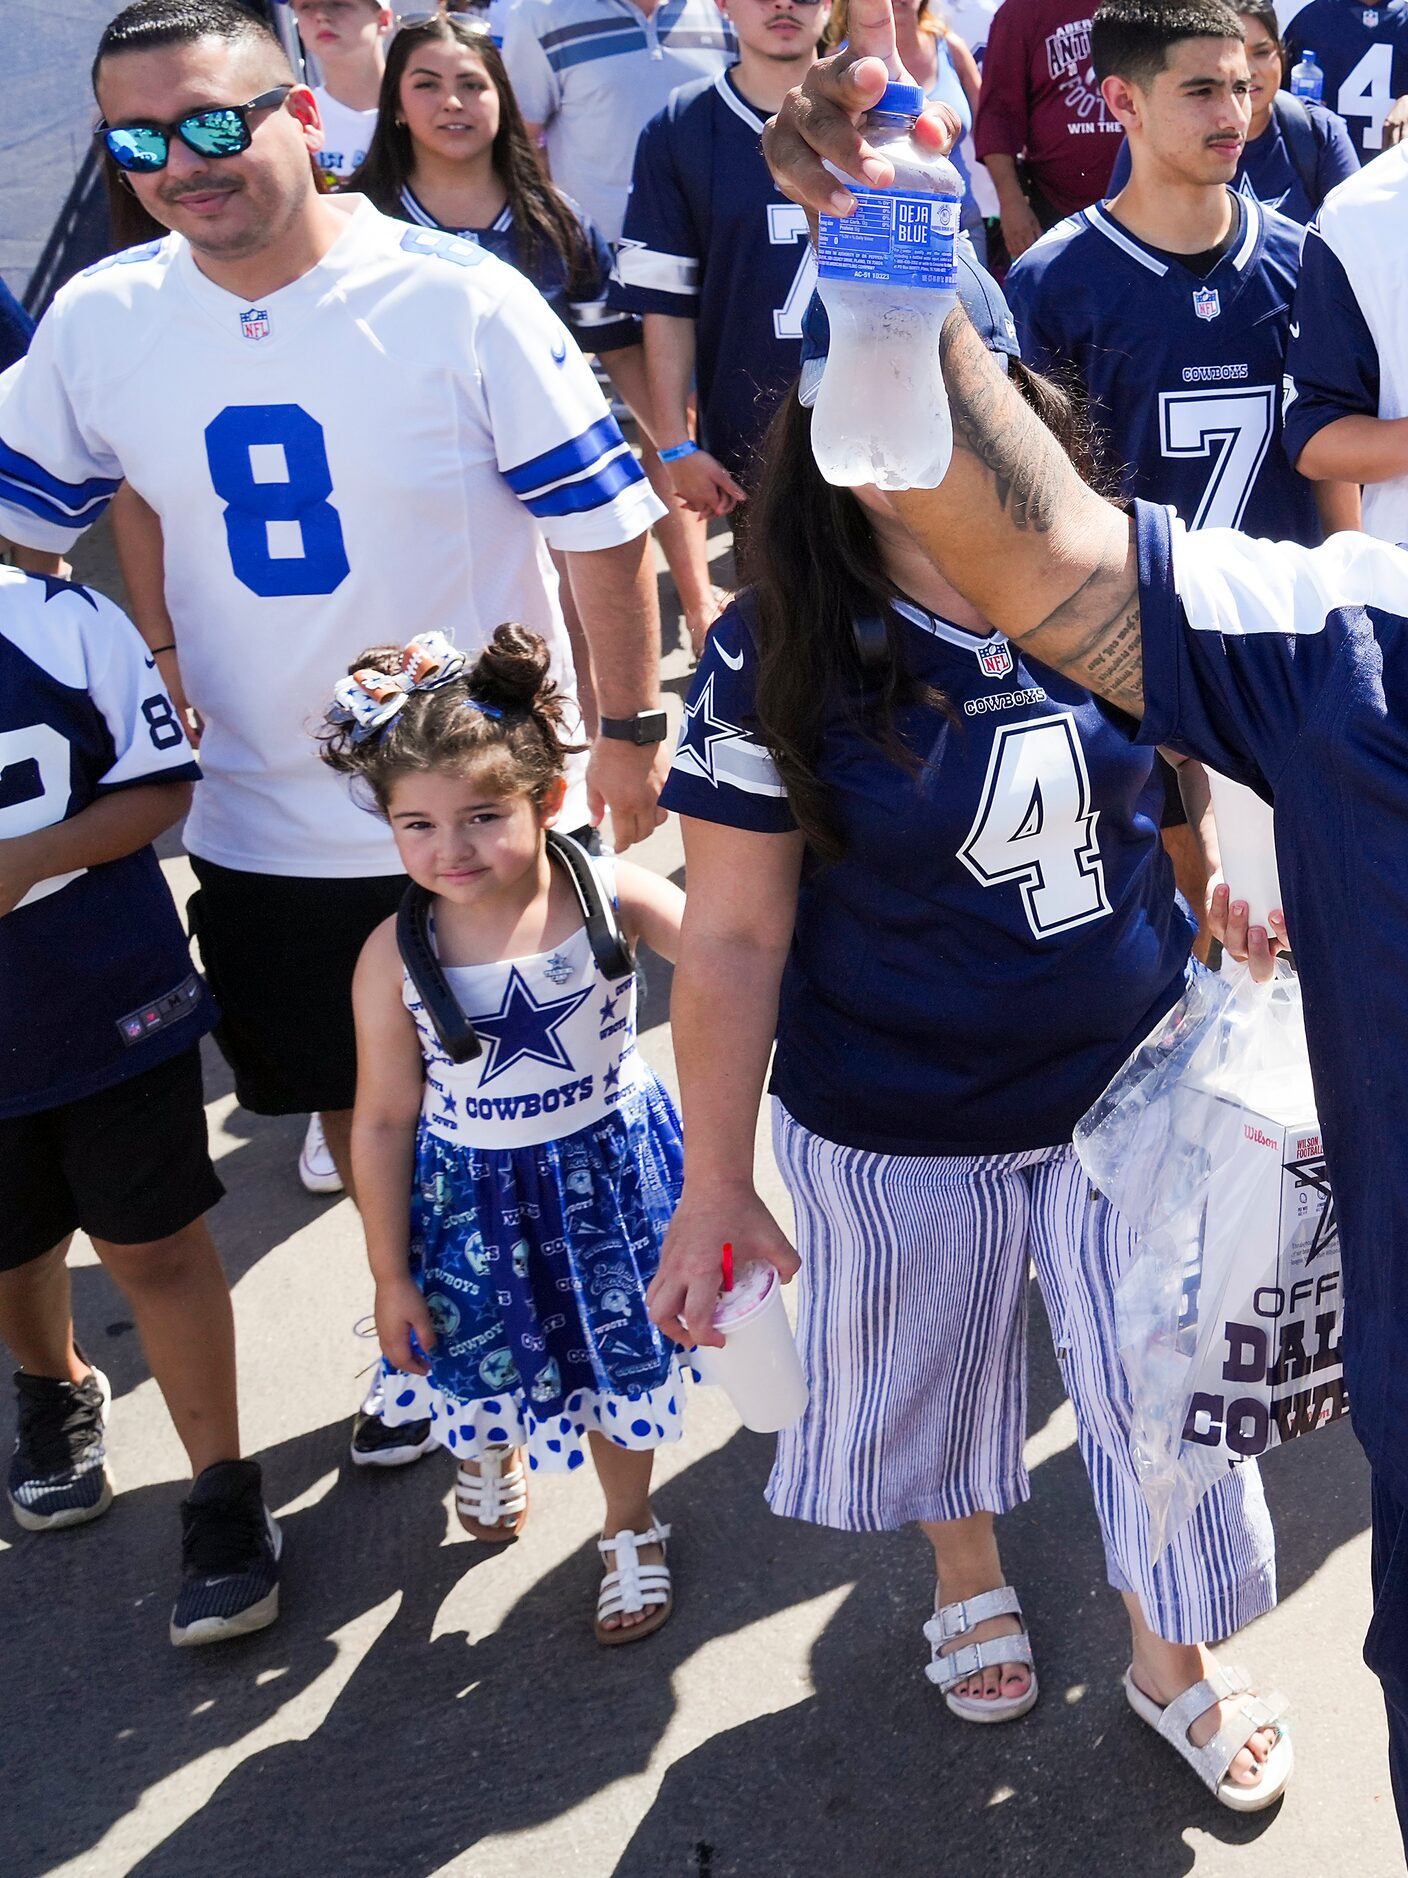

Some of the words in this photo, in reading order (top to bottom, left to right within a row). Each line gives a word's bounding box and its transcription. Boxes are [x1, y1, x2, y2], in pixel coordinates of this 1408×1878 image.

[1338, 43, 1398, 149] 4
[1067, 123, 1095, 134] WIN
[1097, 122, 1122, 133] THE
[900, 204, 928, 223] DEJA
[899, 224, 928, 243] BLUE
[1199, 302, 1217, 315] NFL
[244, 322, 270, 338] NFL
[1182, 363, 1248, 382] COWBOYS
[1158, 384, 1276, 531] 7
[204, 403, 351, 598] 8
[984, 654, 1009, 672] NFL
[964, 687, 1048, 716] COWBOYS
[141, 694, 183, 751] 8
[956, 711, 1113, 940] 4
[466, 1075, 594, 1121] COWBOYS
[1243, 1123, 1279, 1151] Wilson
[1297, 1136, 1319, 1150] WILSON
